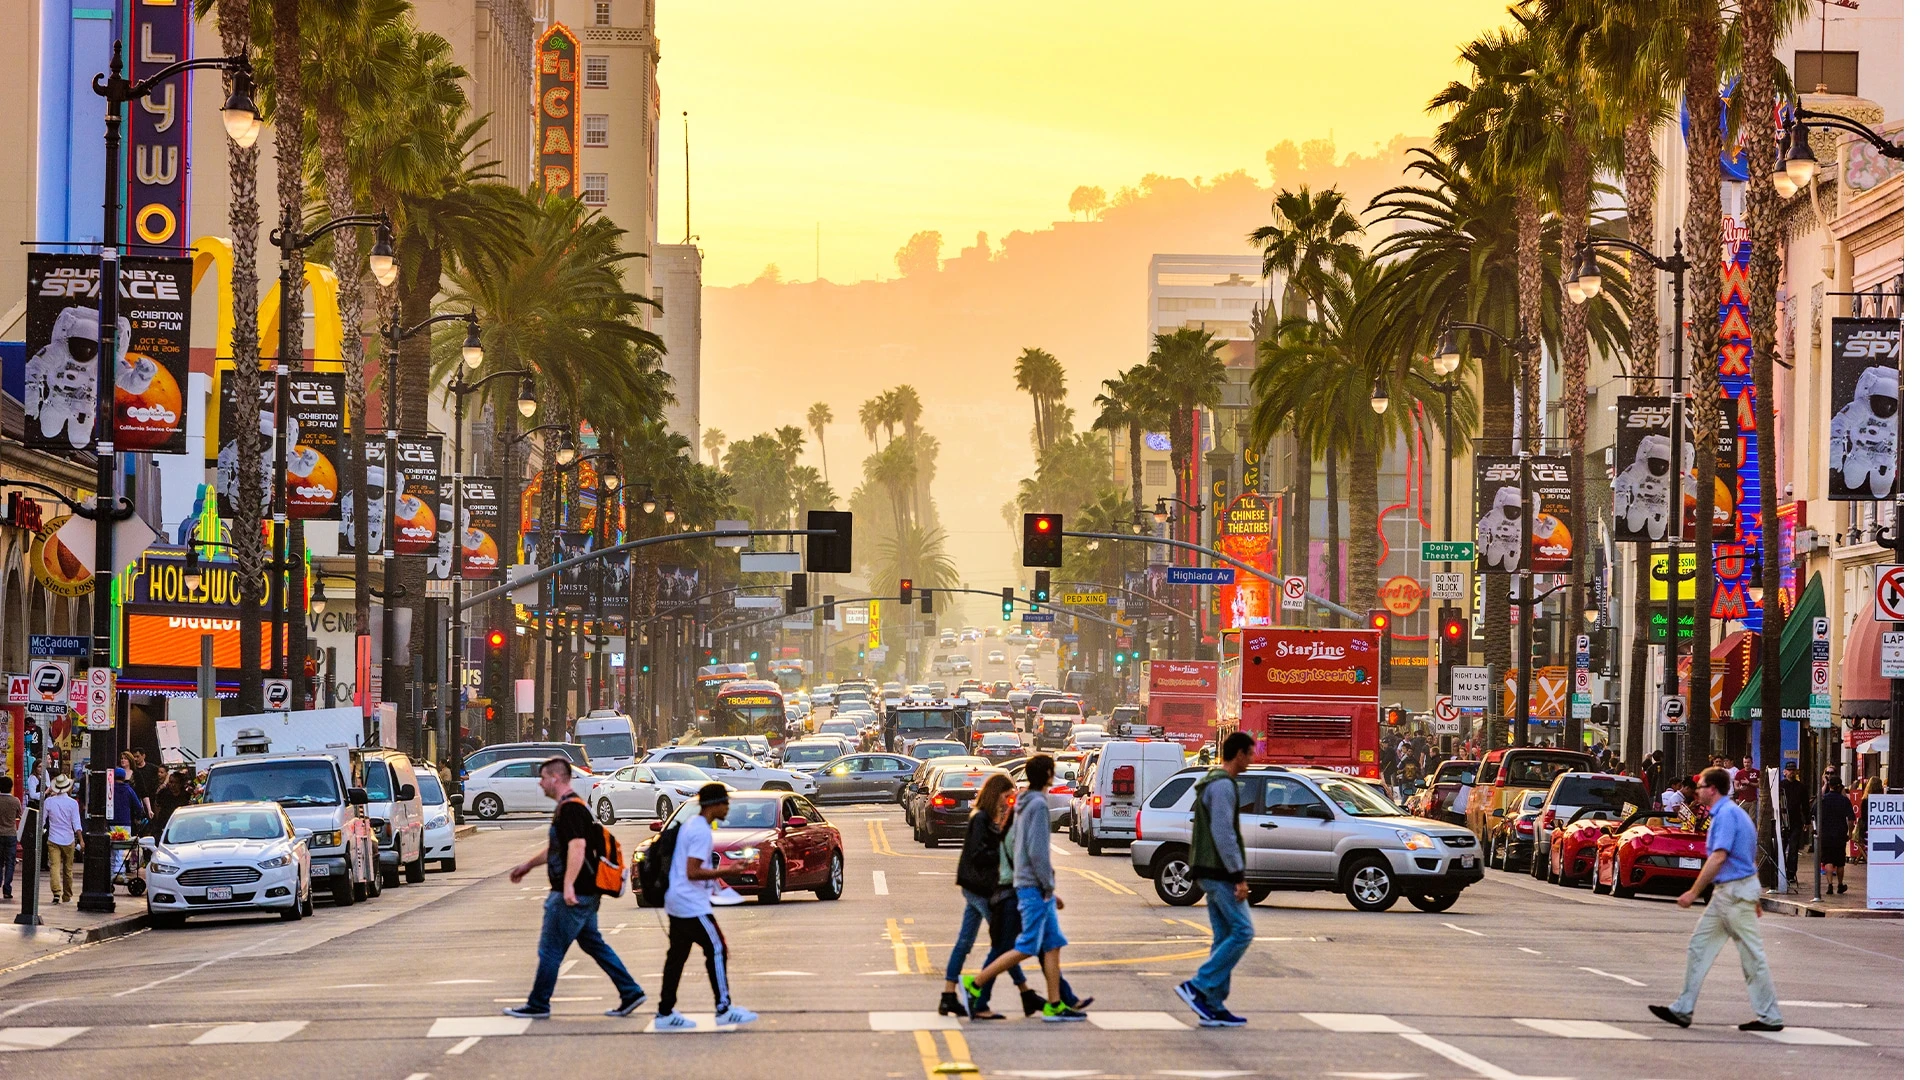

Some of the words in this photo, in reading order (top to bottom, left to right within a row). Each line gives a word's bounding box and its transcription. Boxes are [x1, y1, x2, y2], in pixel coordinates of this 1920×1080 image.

[550, 36, 568, 50] The
[541, 51, 576, 82] EL
[136, 0, 177, 244] LYWO
[131, 311, 183, 321] EXHIBITION
[1720, 260, 1751, 378] WAX
[132, 321, 139, 329] &
[141, 320, 157, 329] 3D
[159, 321, 181, 331] FILM
[1241, 498, 1256, 509] TCL
[1231, 510, 1265, 521] CHINESE
[1227, 522, 1269, 533] THEATRES
[1430, 544, 1454, 552] Dolby
[1173, 571, 1213, 582] Highland
[1217, 572, 1229, 580] Av
[43, 576, 70, 595] Since
[1377, 584, 1401, 598] ard
[1066, 595, 1083, 603] PED
[1085, 595, 1104, 603] XING
[870, 605, 878, 642] INN
[31, 637, 79, 648] McCadden
[1884, 635, 1904, 643] LAP
[31, 647, 47, 655] 1700
[727, 697, 741, 705] 780
[30, 704, 43, 712] PAY
[46, 705, 65, 714] HERE
